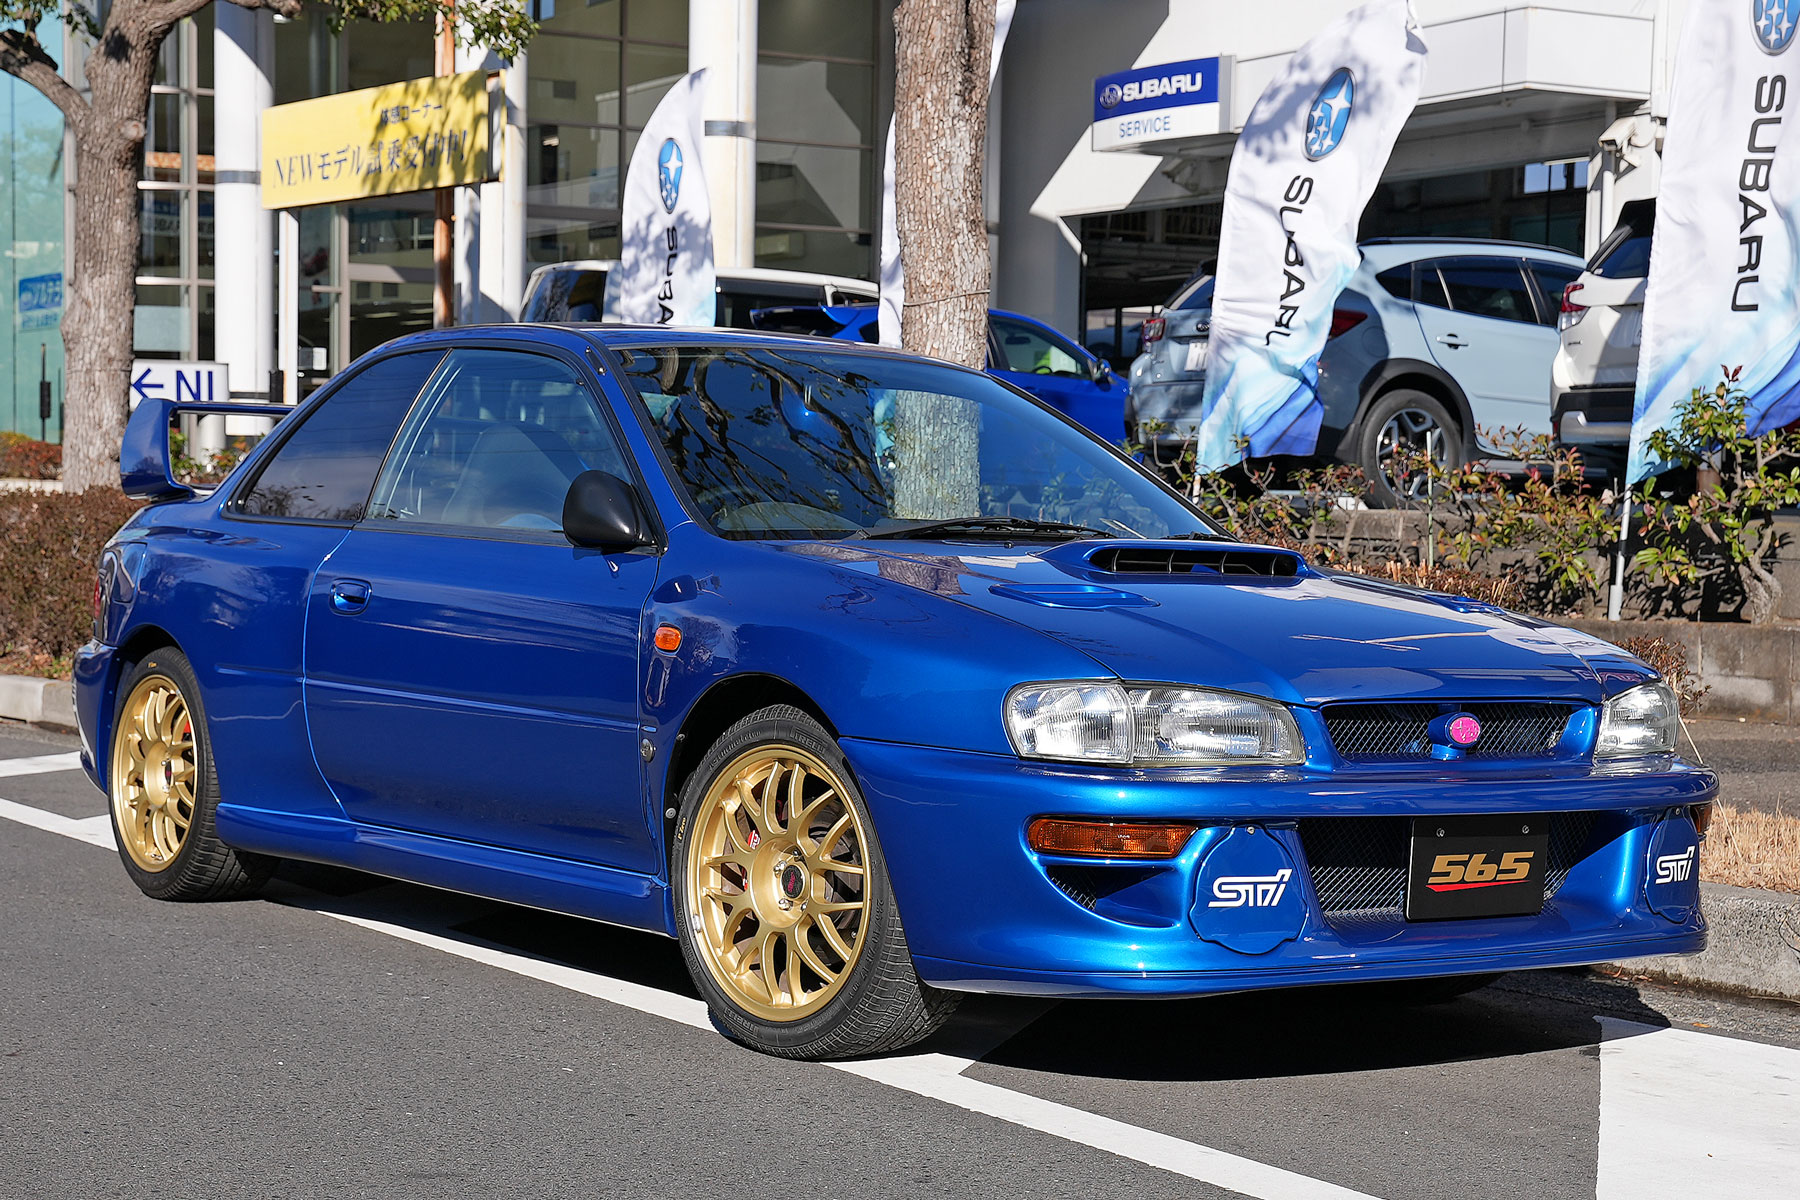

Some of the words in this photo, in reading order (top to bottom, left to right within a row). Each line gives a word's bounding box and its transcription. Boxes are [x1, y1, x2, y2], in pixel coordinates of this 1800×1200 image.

[1122, 71, 1203, 103] SUBARU
[1119, 115, 1171, 138] SERVICE
[1731, 74, 1787, 312] SUBARU
[1427, 851, 1535, 884] 565
